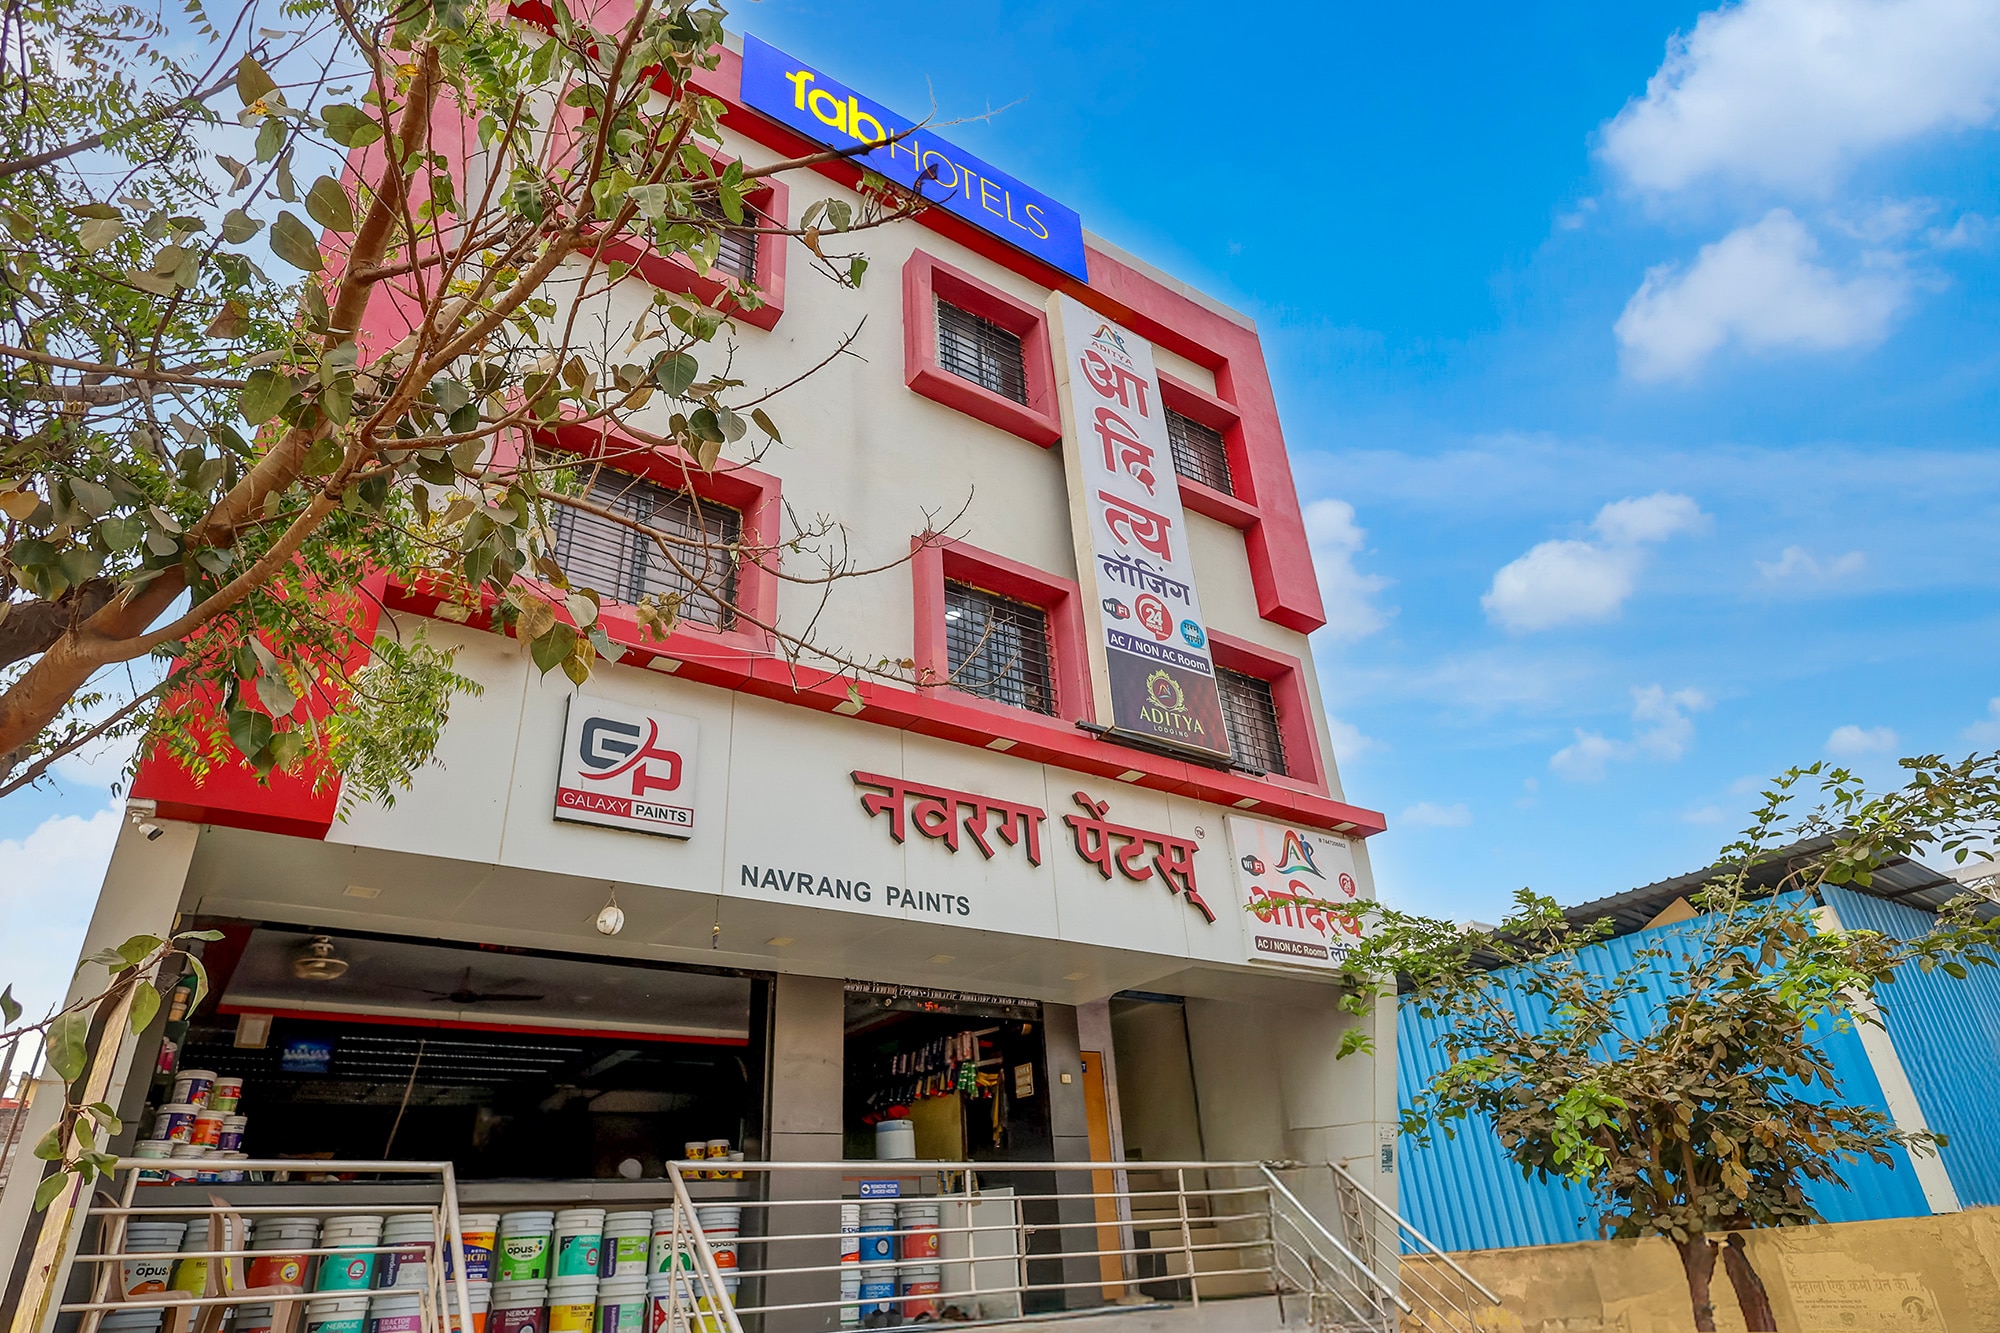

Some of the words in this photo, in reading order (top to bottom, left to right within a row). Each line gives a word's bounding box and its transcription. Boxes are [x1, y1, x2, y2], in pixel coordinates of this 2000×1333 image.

[1091, 341, 1133, 366] ADITYA
[1097, 549, 1190, 606] लॉजिंग
[1146, 607, 1164, 626] 24
[1110, 633, 1126, 646] AC
[1135, 640, 1160, 657] NON
[1162, 649, 1176, 662] AC
[1140, 705, 1205, 735] ADITYA
[1153, 725, 1189, 738] LODGING
[562, 792, 629, 813] GALAXY
[635, 804, 688, 823] PAINTS
[741, 864, 872, 903] NAVRANG
[886, 885, 971, 917] PAINTS
[1257, 938, 1269, 949] AC
[1274, 941, 1291, 952] NON
[1292, 943, 1303, 954] AC
[1304, 945, 1328, 958] Rooms
[507, 1245, 533, 1255] opus
[136, 1266, 168, 1278] opus
[506, 1309, 537, 1317] NEROLAC
